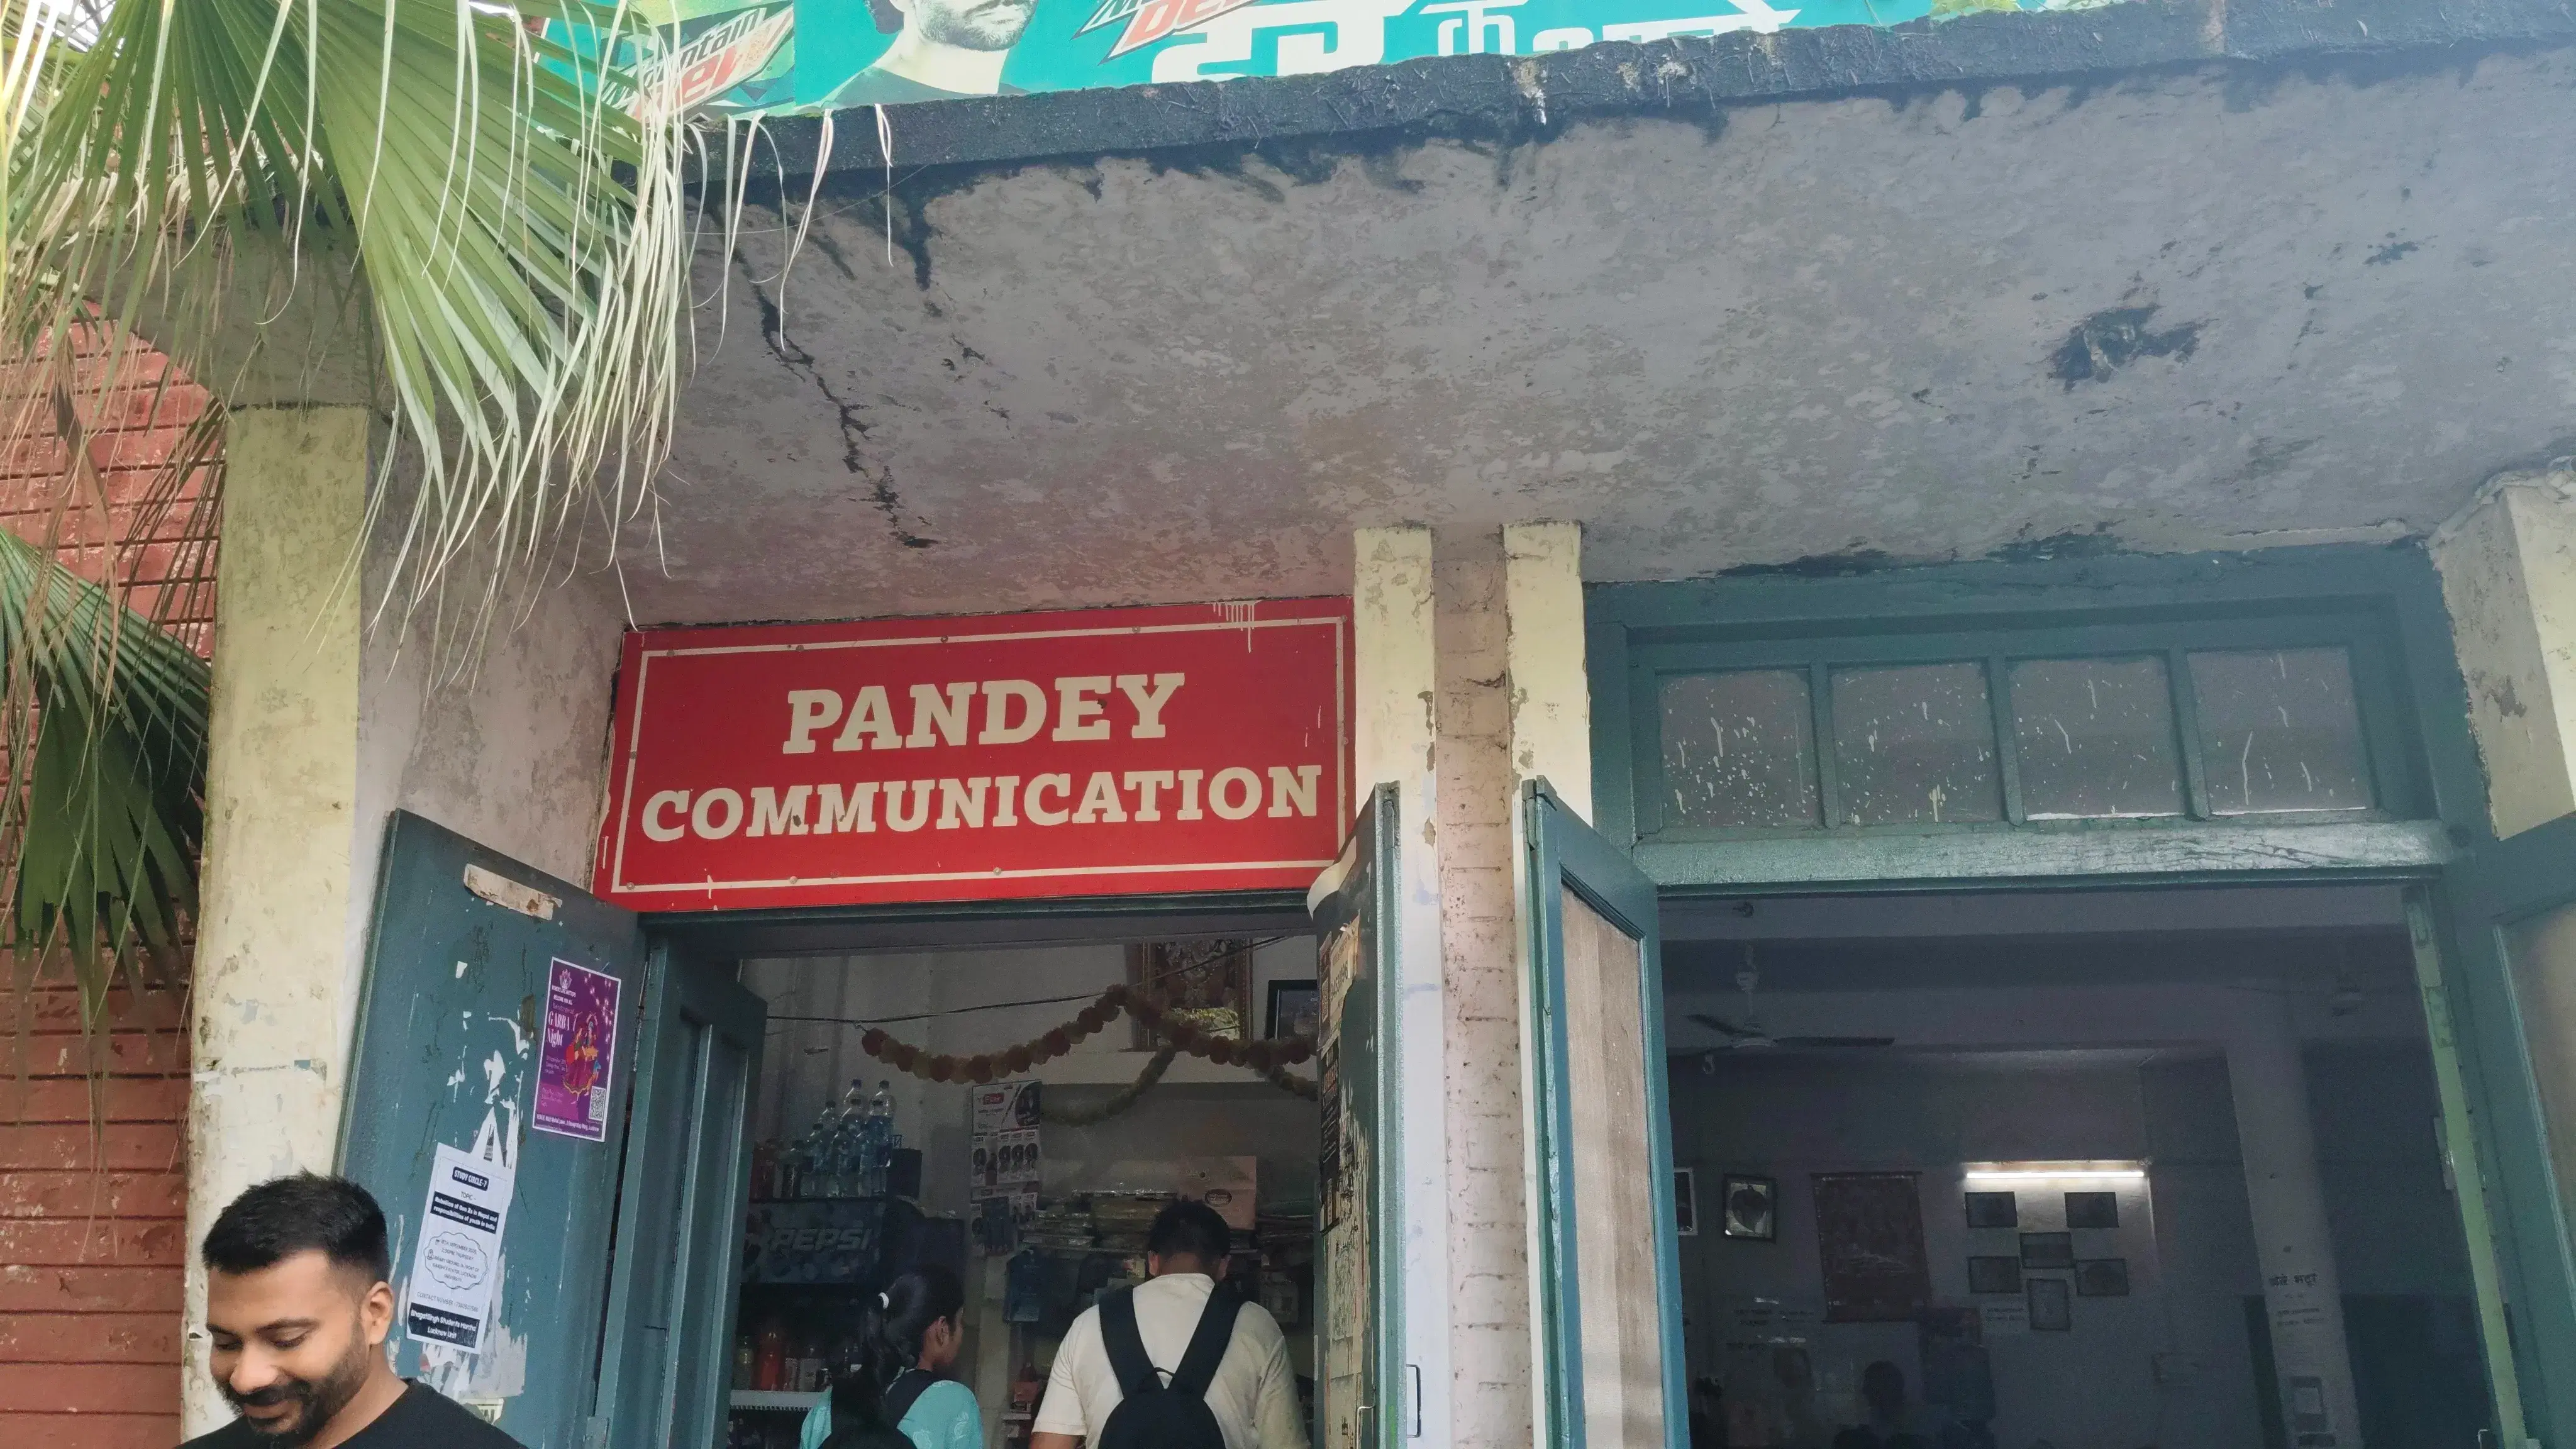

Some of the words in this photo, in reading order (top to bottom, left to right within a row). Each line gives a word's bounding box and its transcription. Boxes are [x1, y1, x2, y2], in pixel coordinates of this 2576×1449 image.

[782, 672, 1185, 755] PANDEY
[641, 765, 1322, 842] COMMUNICATION
[548, 1011, 570, 1031] GARBA
[547, 1028, 564, 1048] Night
[454, 1169, 468, 1181] STUDY
[468, 1175, 487, 1188] CIRCLE-7
[460, 1191, 473, 1200] TOPIC
[478, 1211, 490, 1220] Nepal
[770, 1228, 874, 1251] PEPSI
[417, 1292, 436, 1301] CONTACT
[436, 1297, 453, 1306] NUMBER
[427, 1326, 447, 1337] Lucknow
[447, 1331, 457, 1339] Unit
[440, 1316, 460, 1328] Students
[460, 1323, 477, 1331] Morcha
